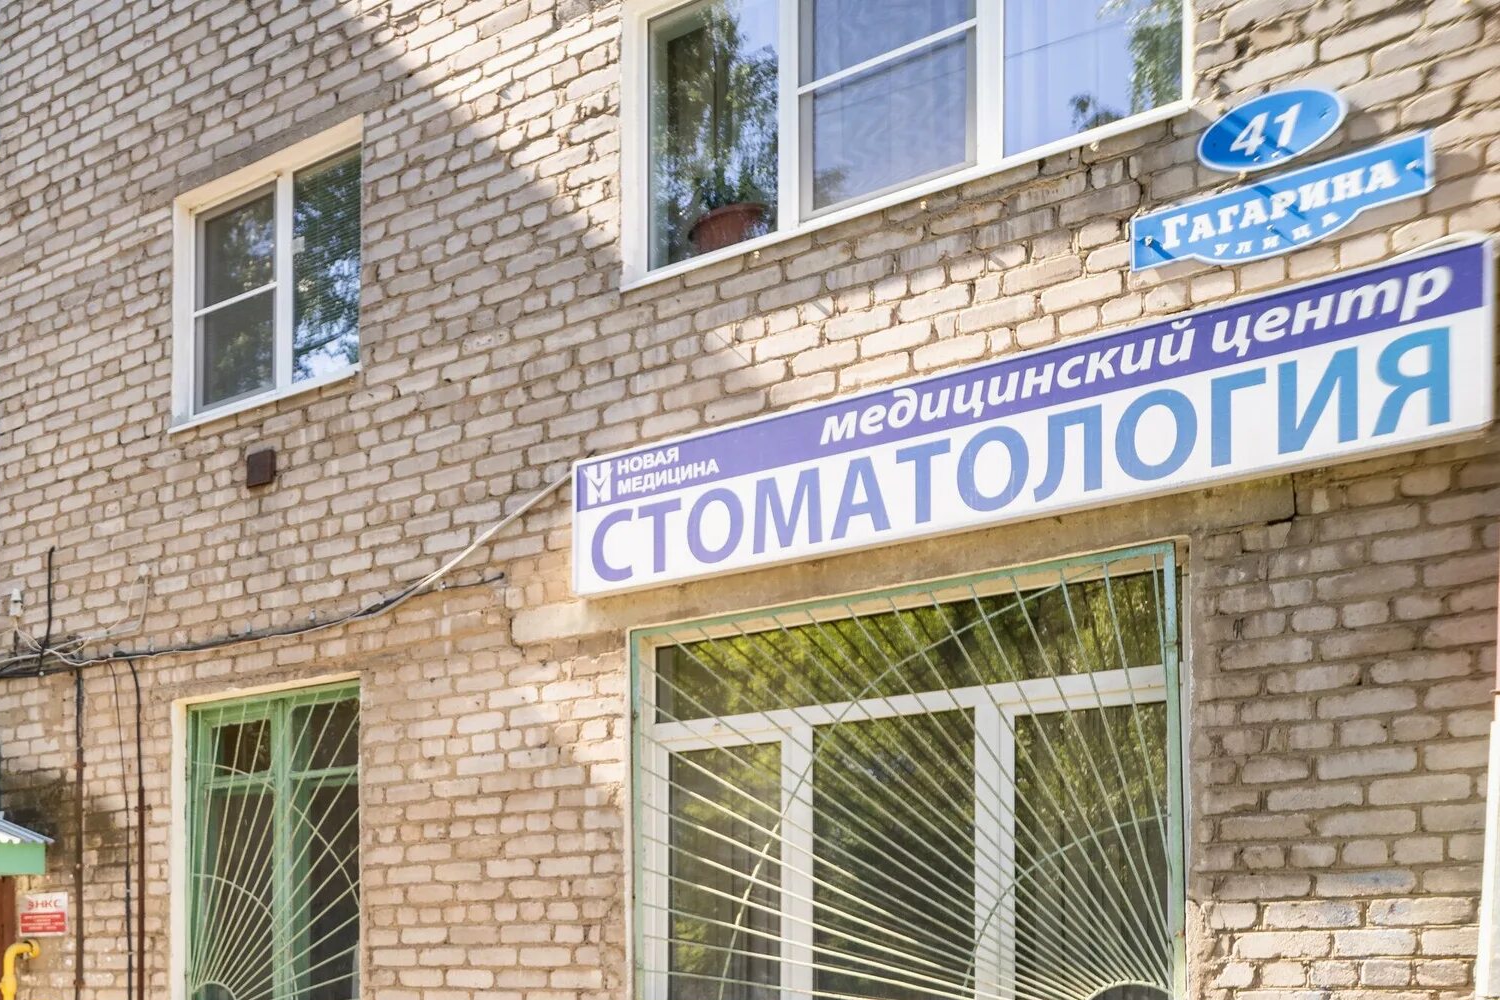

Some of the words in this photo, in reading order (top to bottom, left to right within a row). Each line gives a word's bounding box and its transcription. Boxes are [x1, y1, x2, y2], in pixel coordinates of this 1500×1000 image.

[1229, 102, 1303, 156] 41
[1161, 159, 1400, 250] ГАГАРИНА
[820, 319, 1198, 446] медицинский
[1211, 263, 1455, 356] центр
[591, 325, 1452, 582] СТОМАТОЛОГИЯ
[617, 446, 680, 476] НОВАЯ
[617, 458, 720, 495] МЕДИЦИНА
